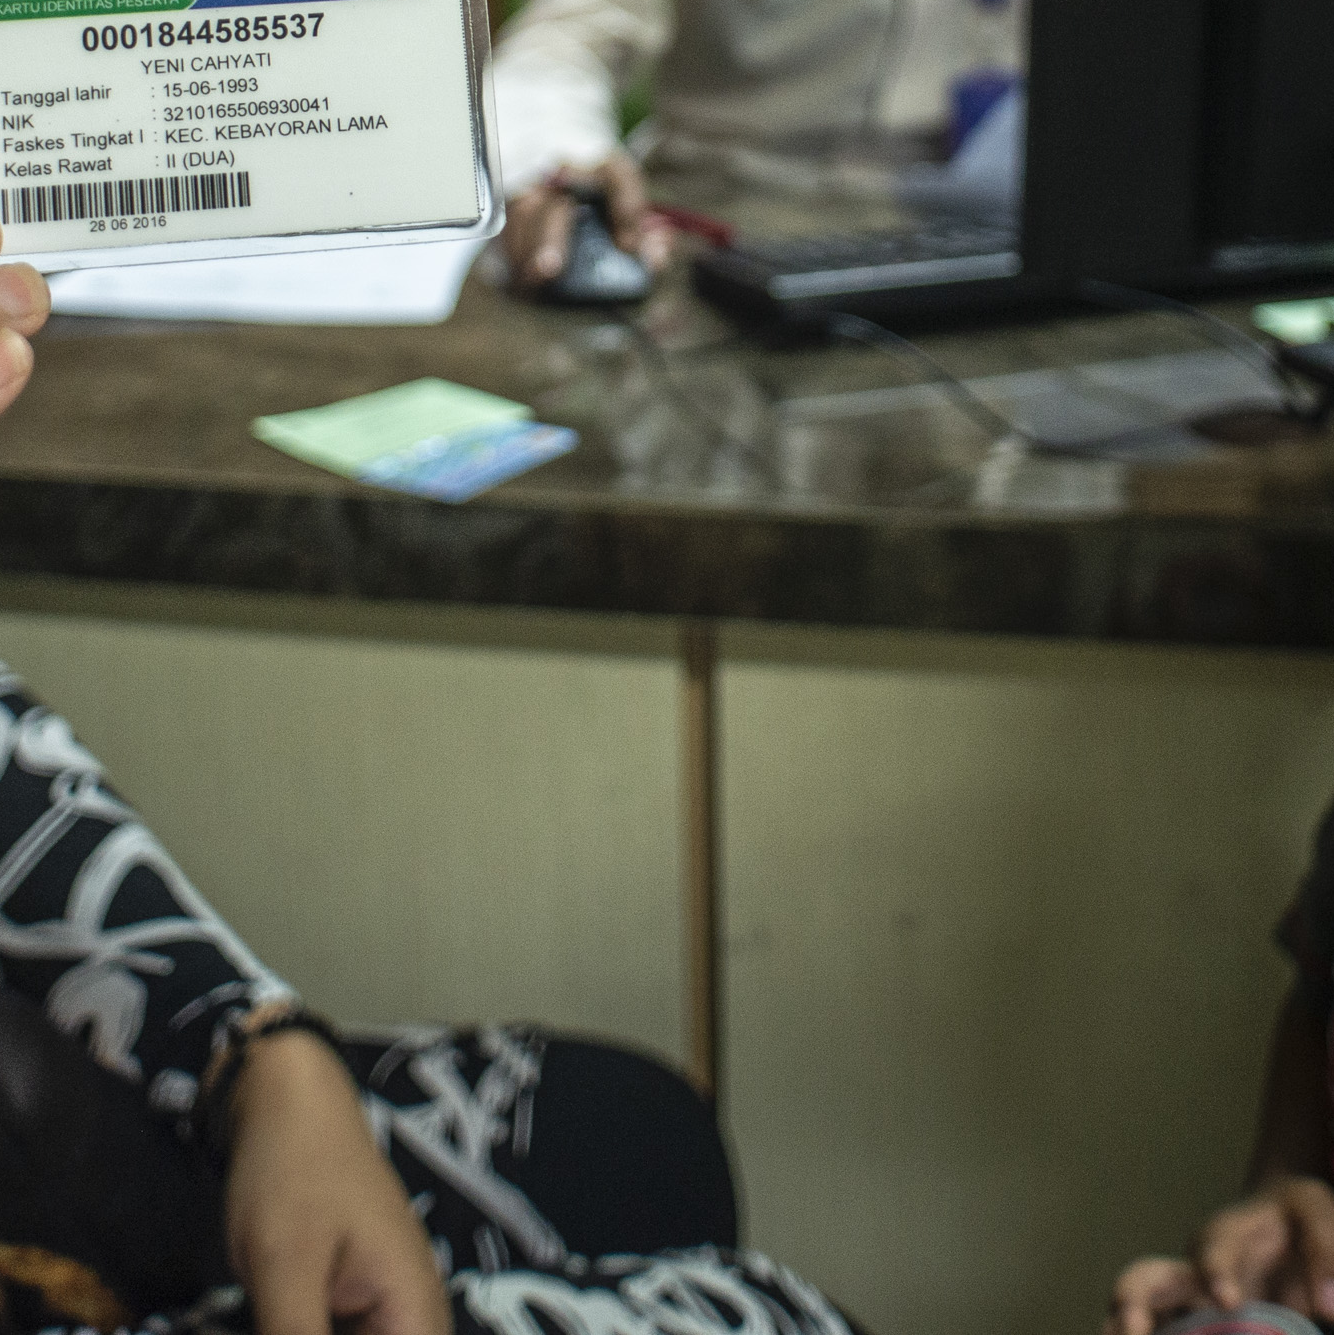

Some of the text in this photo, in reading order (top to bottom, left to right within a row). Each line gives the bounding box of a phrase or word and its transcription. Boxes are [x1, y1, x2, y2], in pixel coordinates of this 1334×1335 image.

[82, 12, 325, 52] 0001844585537
[141, 52, 272, 75] YENI CAHYATI
[1, 87, 70, 107] Tanggal
[76, 85, 112, 101] lahir
[163, 77, 259, 98] 15-06-1993
[2, 114, 34, 131] NIK
[163, 97, 330, 122] 3210165506930041
[3, 135, 65, 153] Faskes
[71, 131, 134, 150] Tingkat
[165, 127, 209, 144] KEC.
[215, 119, 331, 141] KEBAYORAN
[337, 115, 388, 132] LAMA
[4, 161, 52, 178] Kelas
[58, 156, 112, 174] Rawat
[183, 150, 235, 171] (DUA)
[90, 215, 167, 233] 28 06 2016
